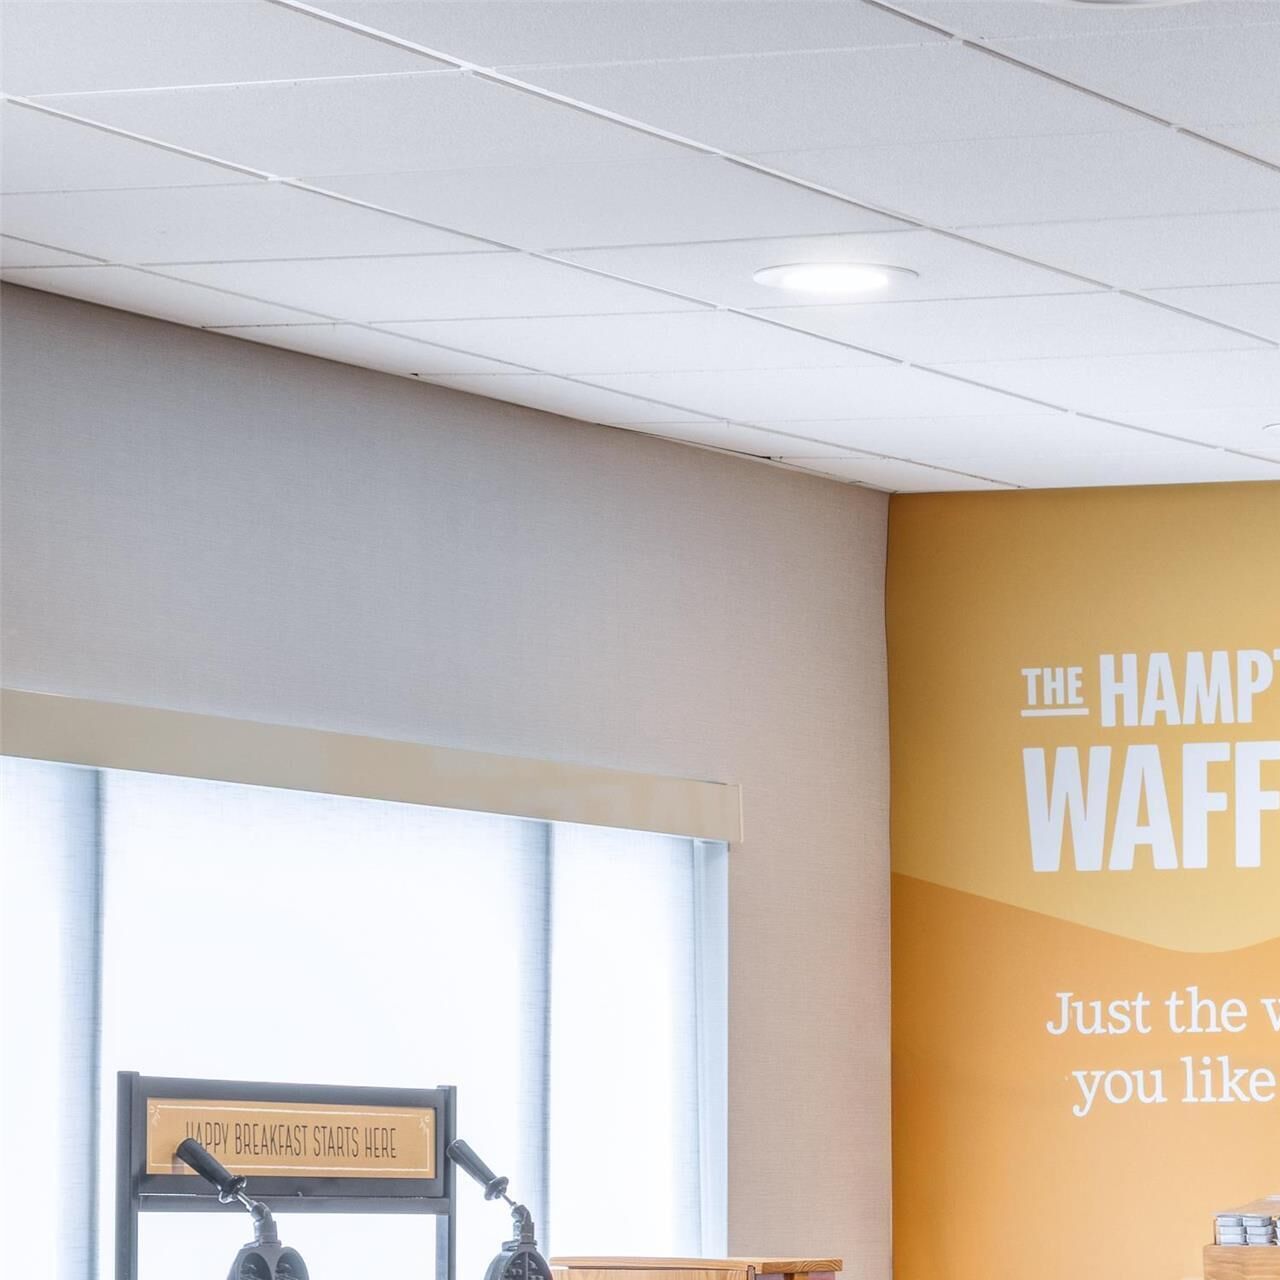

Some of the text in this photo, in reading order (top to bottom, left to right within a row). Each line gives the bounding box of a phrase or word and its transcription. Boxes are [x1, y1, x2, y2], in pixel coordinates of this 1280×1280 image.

[1021, 666, 1084, 706] THE
[1046, 991, 1152, 1035] Just
[1164, 986, 1248, 1033] the
[1071, 1069, 1168, 1117] you
[1180, 1055, 1277, 1103] like
[234, 1122, 308, 1156] BREAKFAST
[313, 1124, 360, 1158] STARTS
[364, 1127, 398, 1159] HERE
